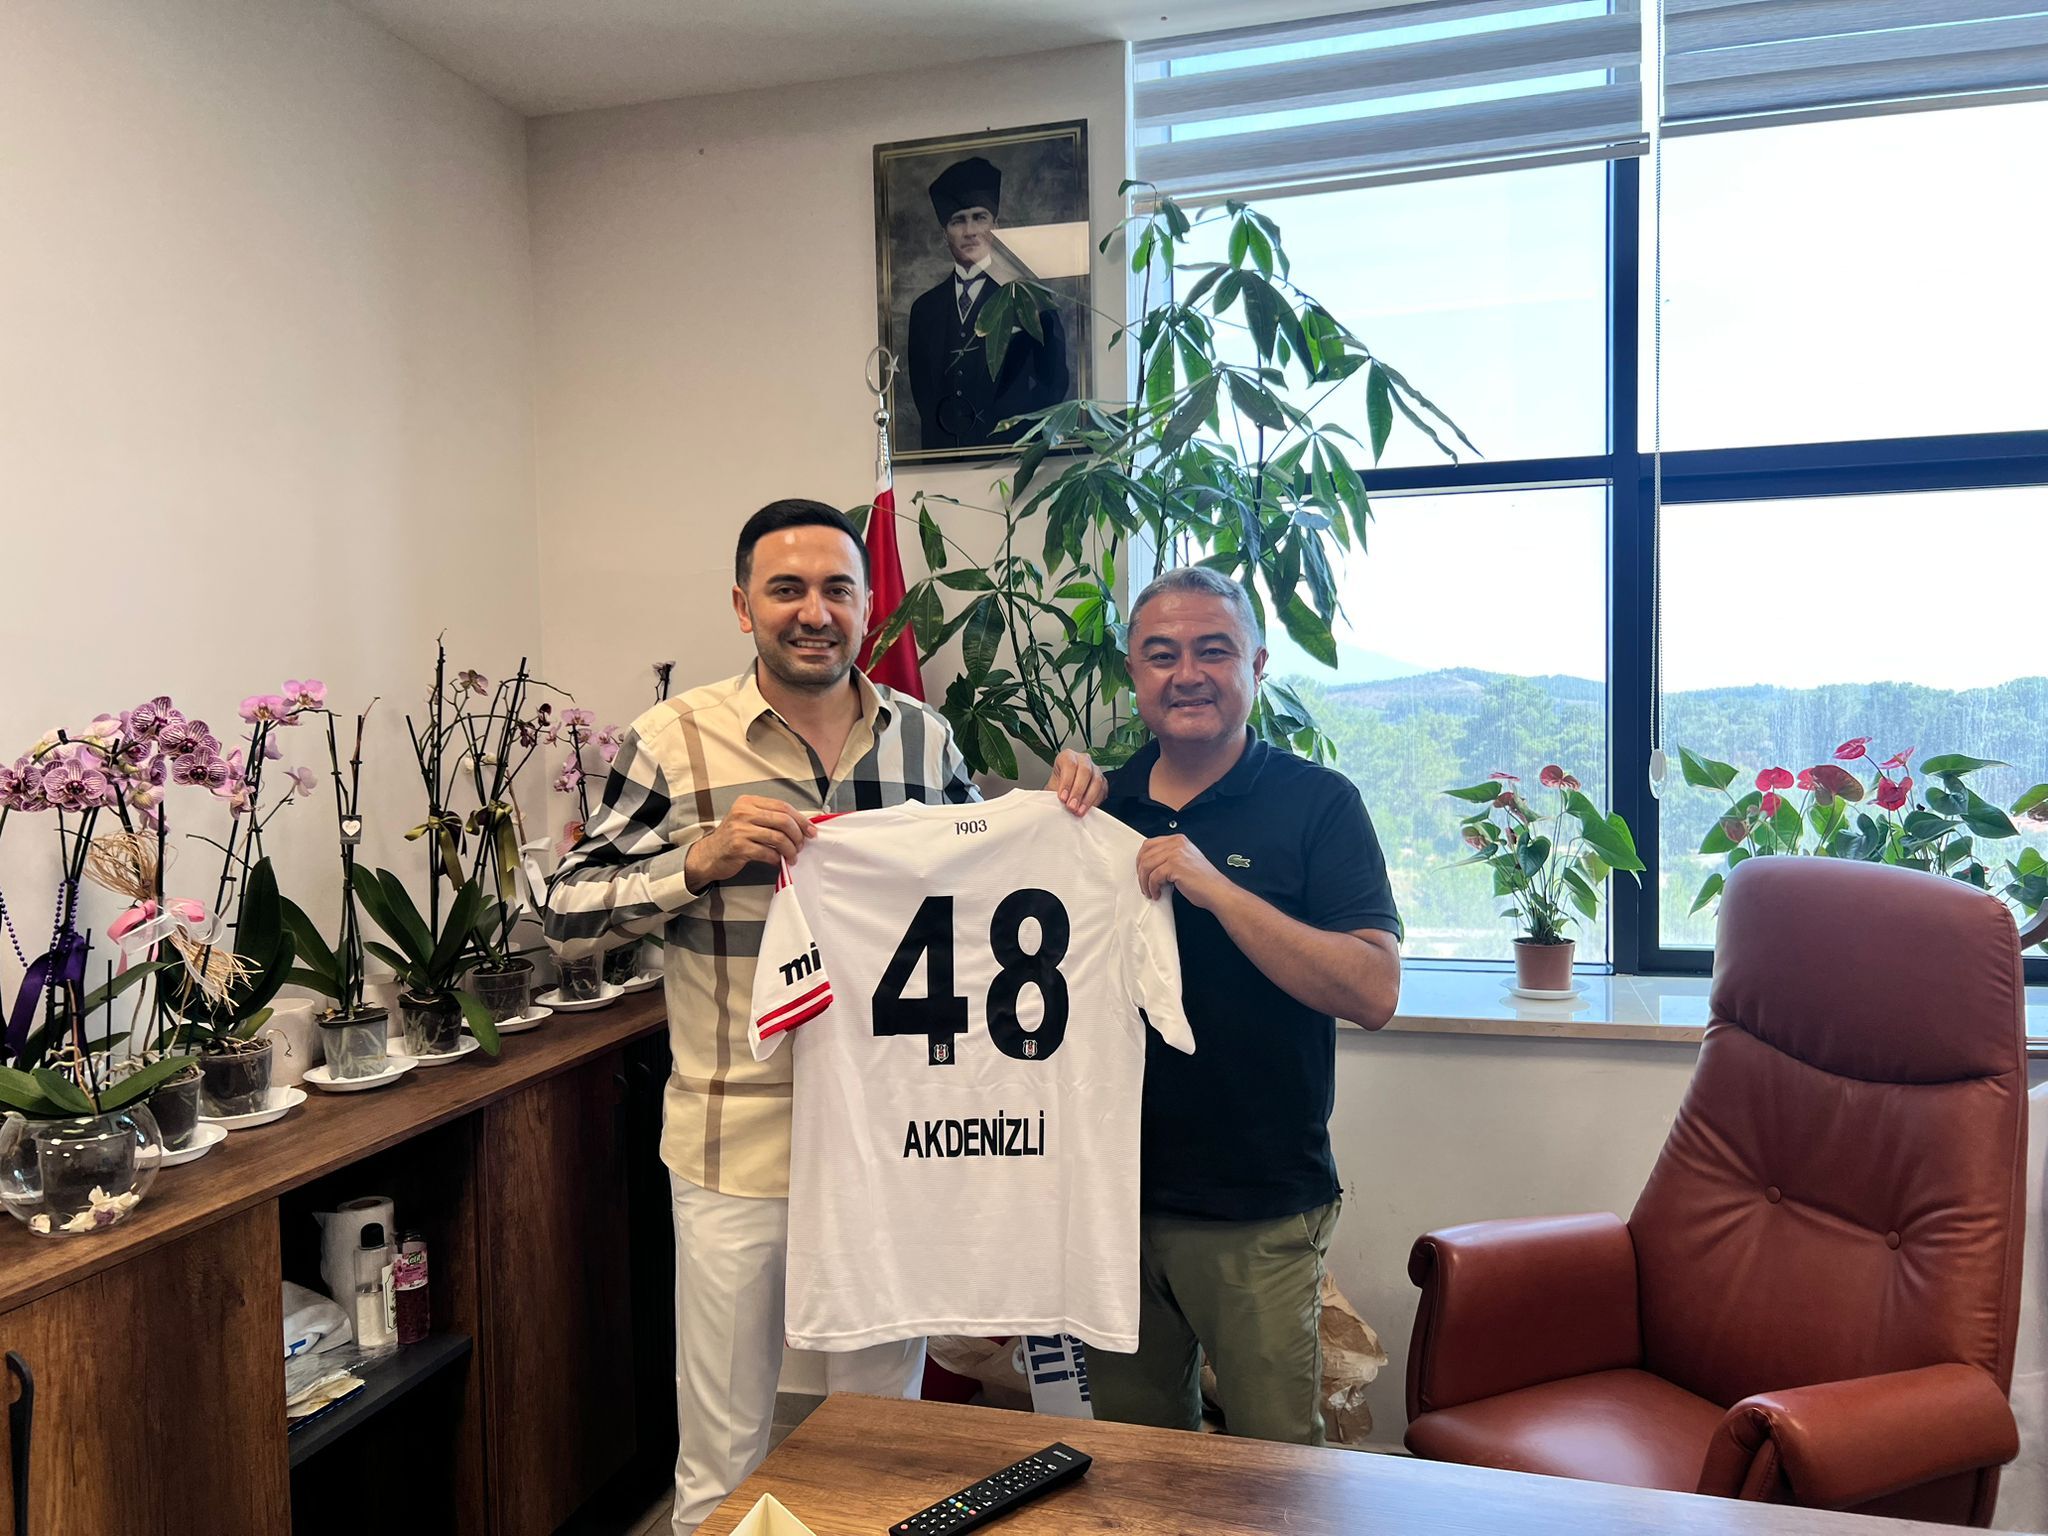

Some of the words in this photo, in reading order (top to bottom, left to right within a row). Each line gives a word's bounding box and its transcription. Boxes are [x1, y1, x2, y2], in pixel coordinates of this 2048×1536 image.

[954, 819, 987, 835] 1903
[872, 888, 1070, 1066] 48
[903, 1110, 1044, 1158] AKDENİZLİ
